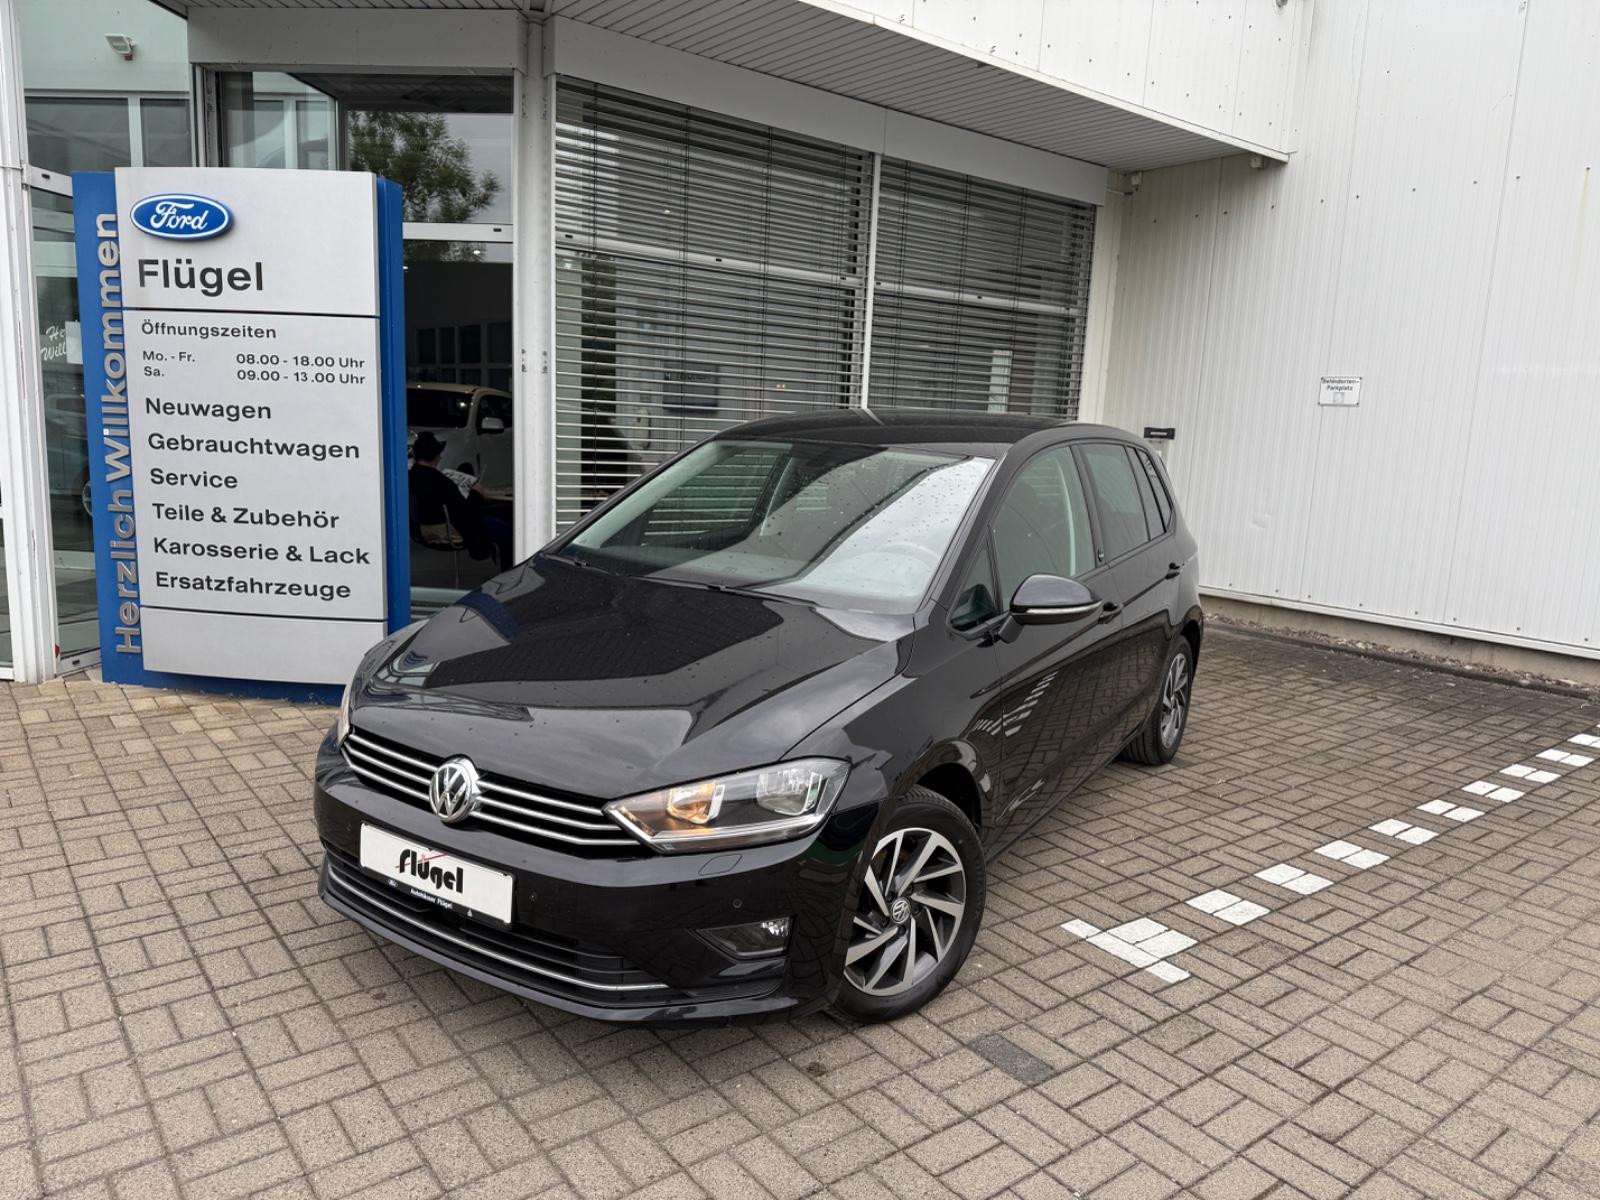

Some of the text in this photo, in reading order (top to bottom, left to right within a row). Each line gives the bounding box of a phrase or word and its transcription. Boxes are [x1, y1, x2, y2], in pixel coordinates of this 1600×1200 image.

[149, 201, 209, 230] Ford
[138, 258, 263, 298] Flügel
[141, 318, 277, 340] Öffnungszeiten
[142, 350, 168, 362] Mo.
[178, 351, 196, 363] Fr.
[236, 353, 280, 366] 08.00
[292, 355, 335, 368] 18.00
[338, 356, 365, 369] Uhr
[143, 365, 165, 377] Sa.
[236, 369, 280, 382] 09.00
[293, 371, 336, 385] 13.00
[339, 373, 366, 385] Uhr
[145, 397, 272, 423] Neuwagen
[96, 212, 142, 654] Herzlich Willkommen
[147, 432, 360, 462] Gebrauchtwagen
[149, 467, 238, 489] Service
[151, 502, 340, 529] Teile & Zubehör
[153, 536, 371, 566] Karosserie & Lack
[155, 571, 351, 602] Ersatzfahrzeuge
